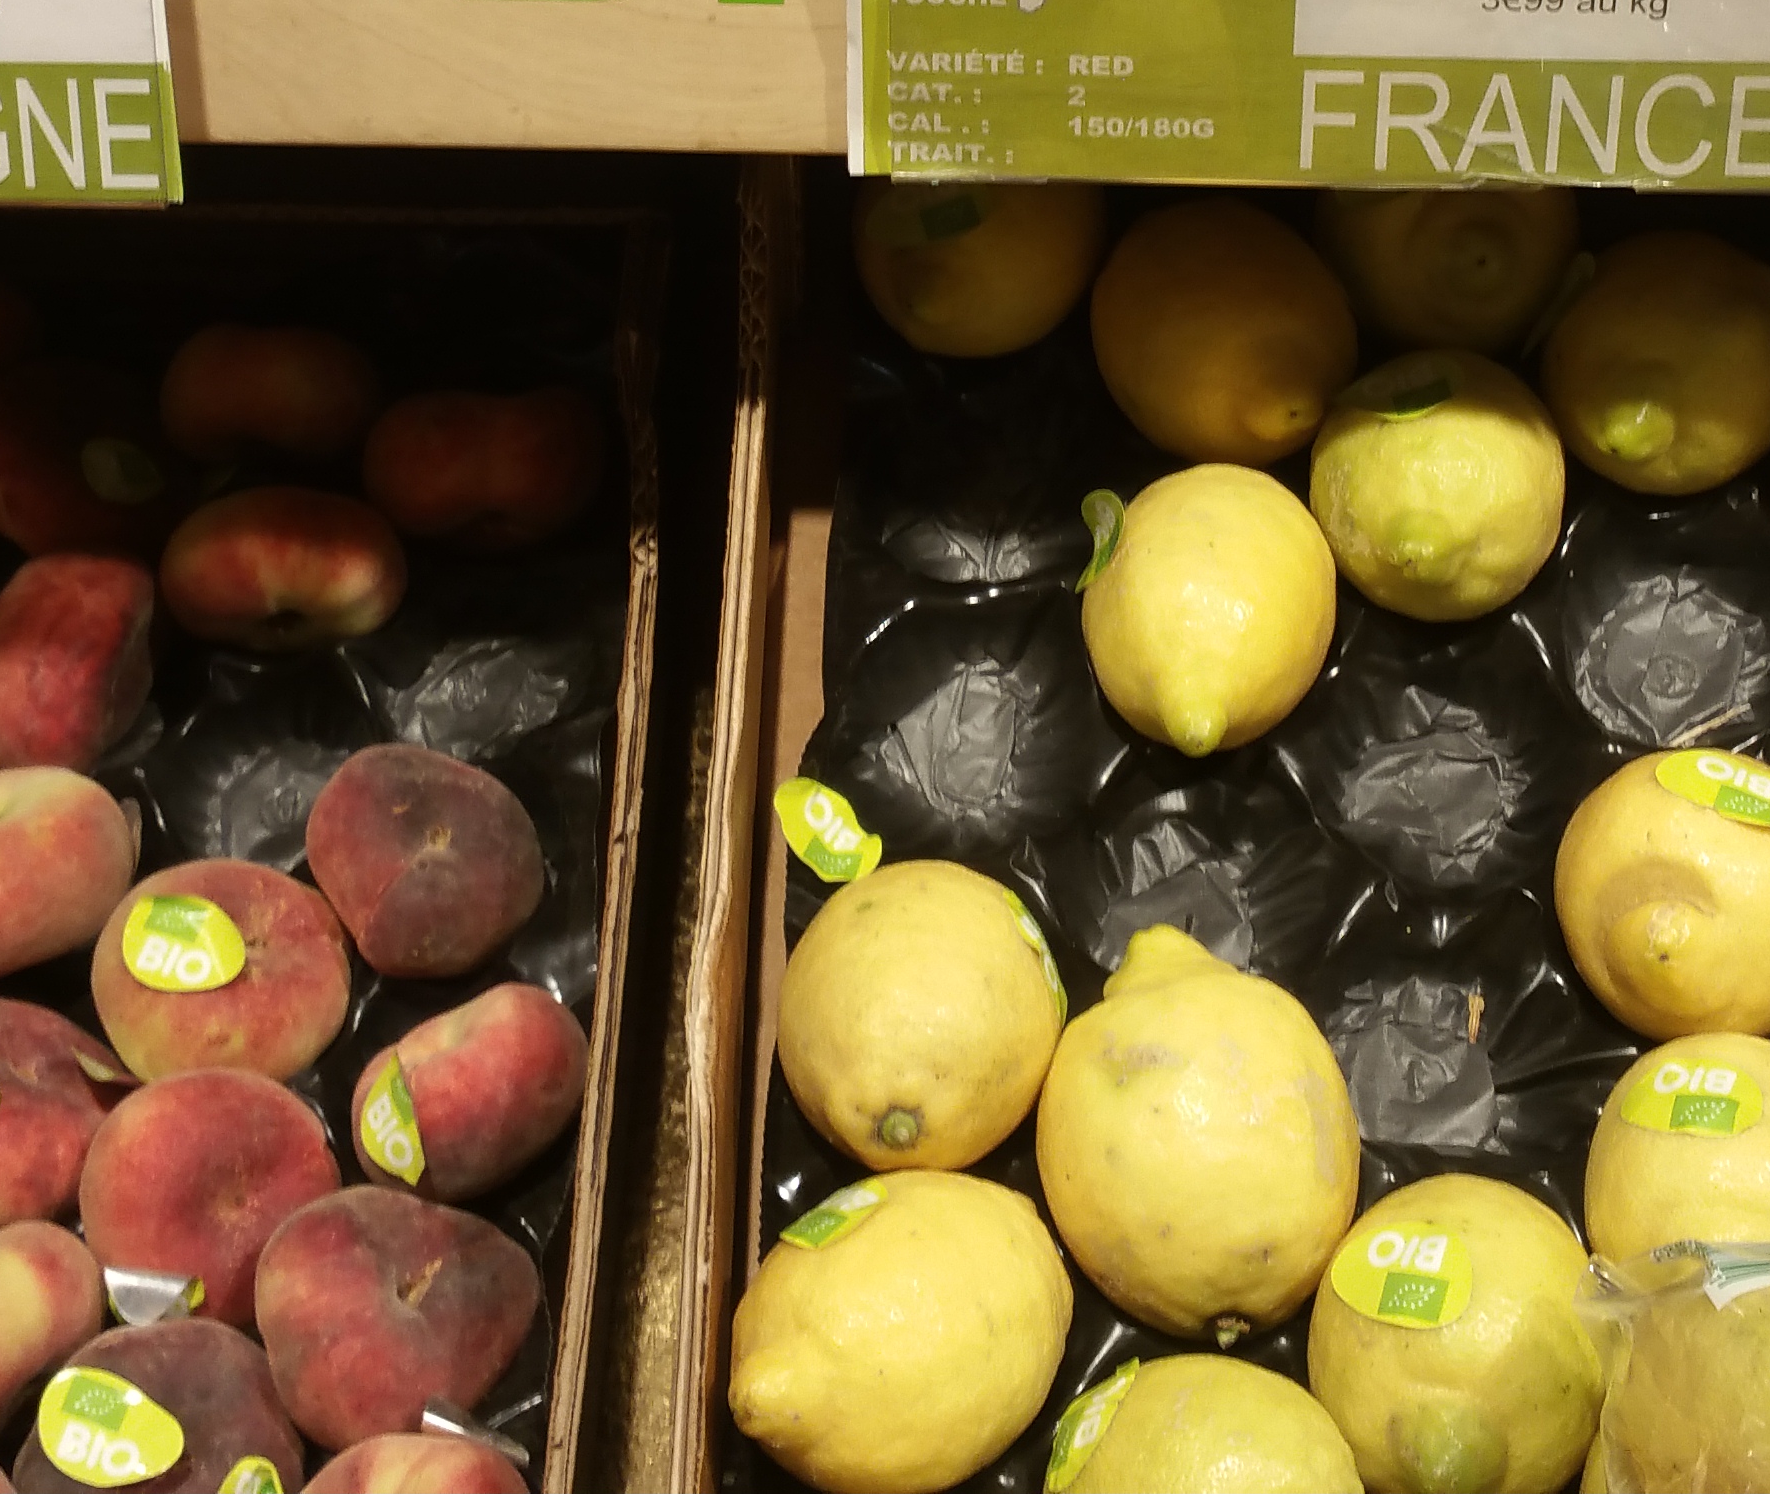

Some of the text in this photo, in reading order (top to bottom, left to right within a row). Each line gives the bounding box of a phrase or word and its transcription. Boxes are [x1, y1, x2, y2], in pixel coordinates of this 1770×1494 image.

[886, 48, 1025, 75] VARIÉTÉ
[1068, 54, 1134, 77] RED
[887, 82, 962, 104] CAT.
[1067, 84, 1087, 108] 2
[1068, 115, 1216, 138] 150/180G
[886, 139, 994, 164] TRAIT.
[803, 791, 864, 852] BIO
[136, 933, 206, 988] BIO
[1653, 1069, 1737, 1098] BIO
[365, 1101, 415, 1168] BIO
[1367, 1230, 1450, 1273] BIO
[56, 1416, 143, 1478] BIO
